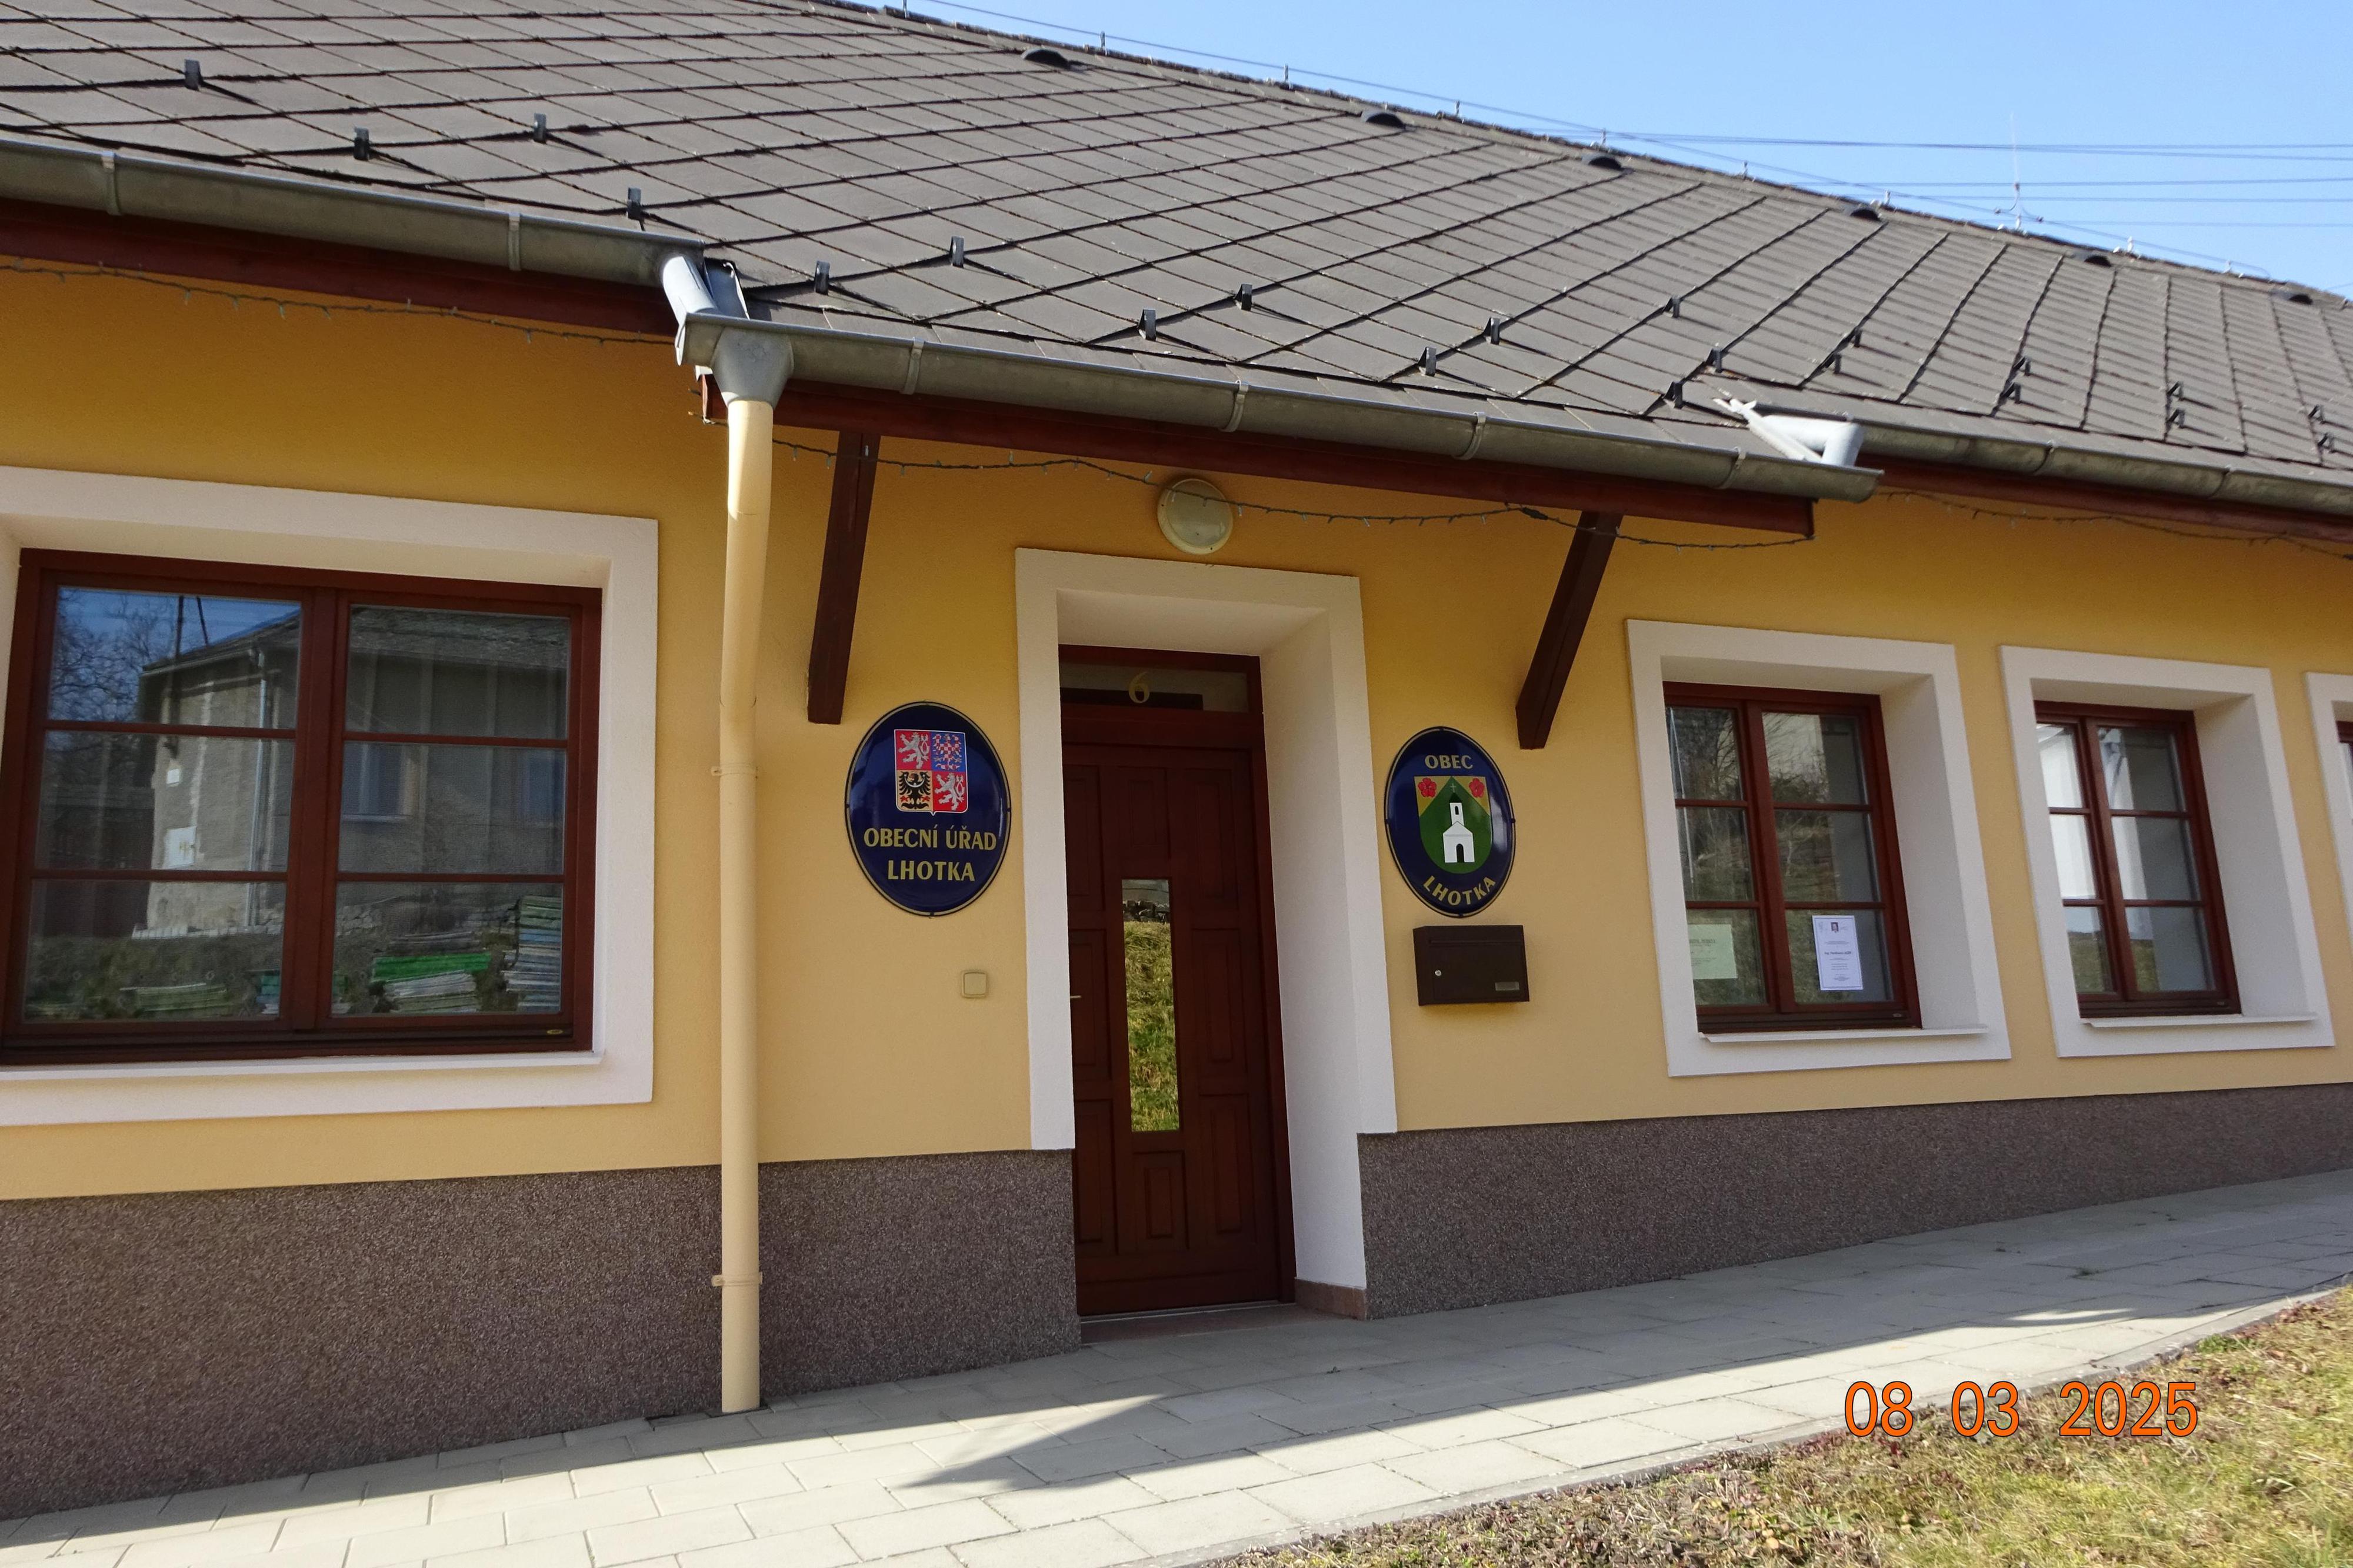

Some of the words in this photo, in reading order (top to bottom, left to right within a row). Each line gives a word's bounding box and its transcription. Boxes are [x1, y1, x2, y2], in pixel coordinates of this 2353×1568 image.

[1128, 672, 1150, 703] 6
[1424, 755, 1474, 769] OBEC
[864, 824, 938, 848] OBECNÍ
[945, 825, 997, 850] ÚŘAD
[887, 860, 975, 882] LHOTKA
[1423, 875, 1497, 906] LHOTKA
